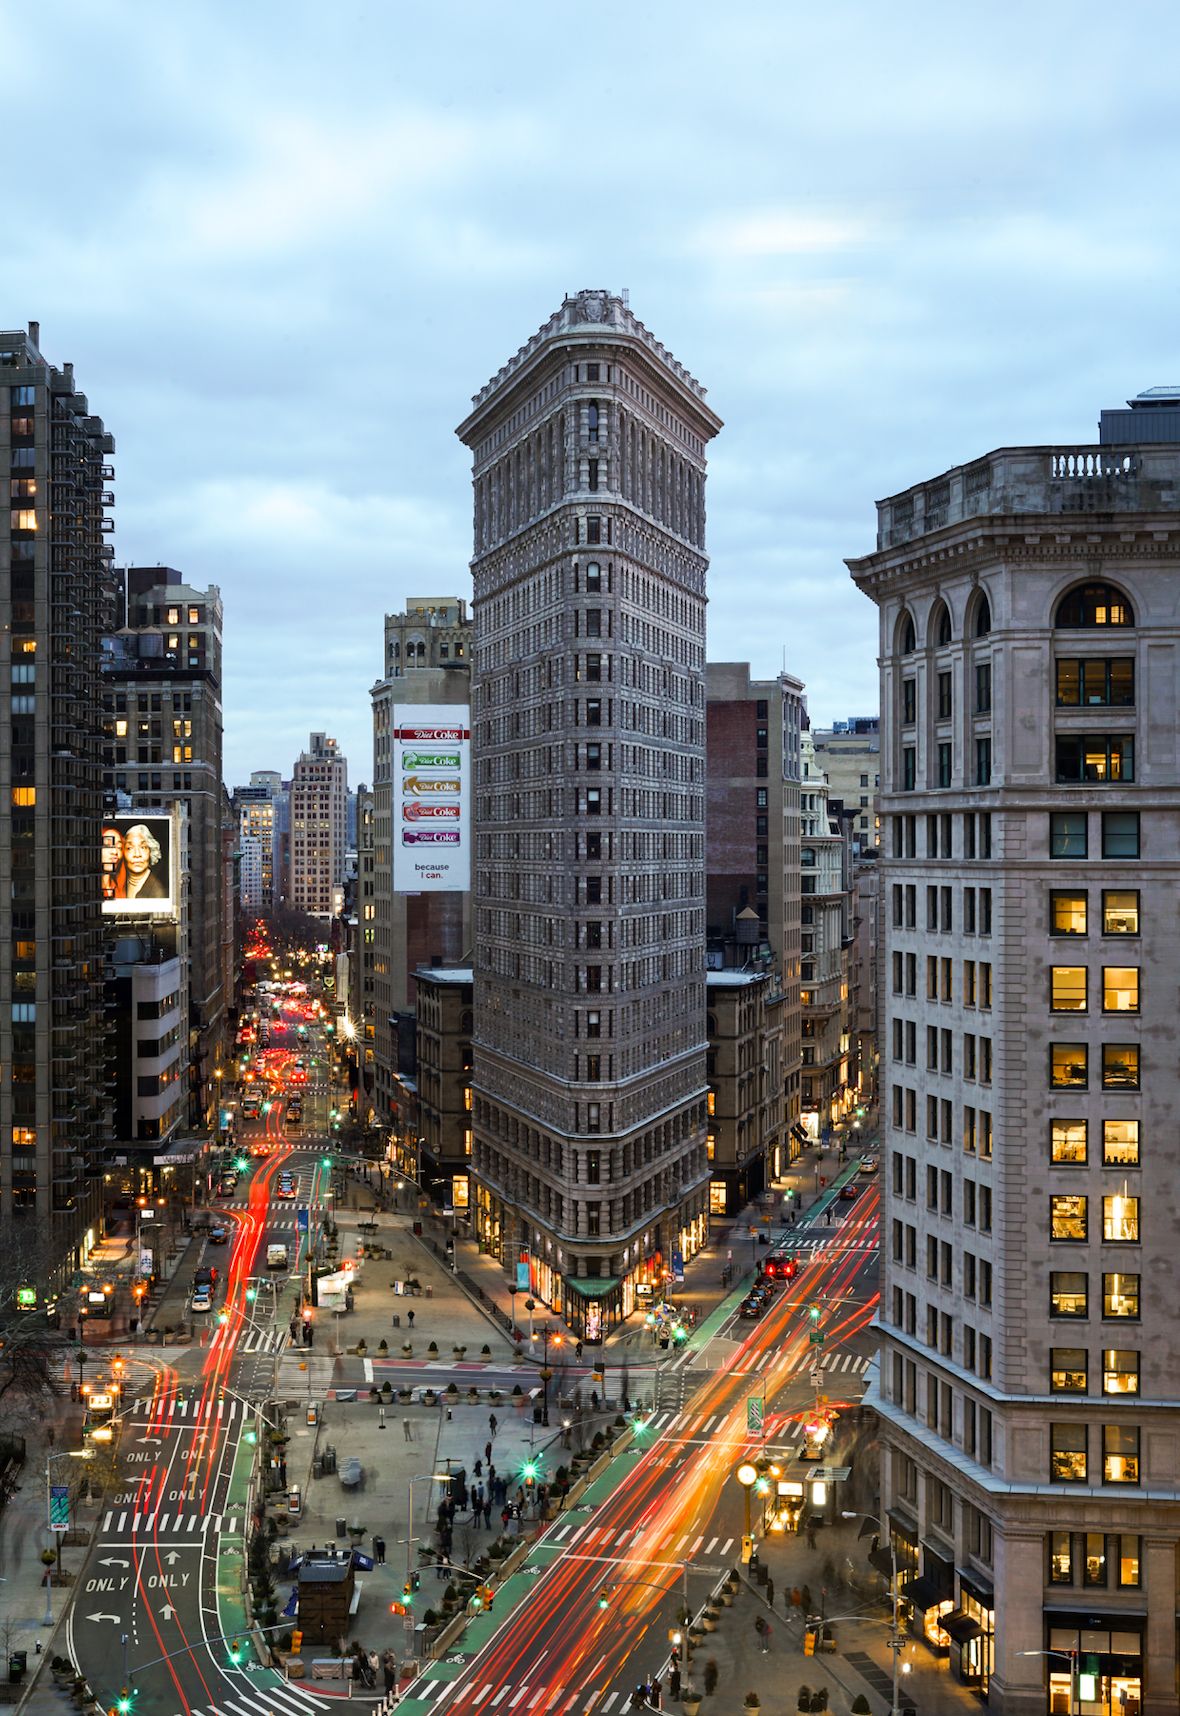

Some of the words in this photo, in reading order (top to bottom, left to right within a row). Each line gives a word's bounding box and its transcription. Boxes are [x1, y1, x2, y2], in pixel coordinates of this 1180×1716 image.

[414, 730, 433, 739] Diet
[434, 730, 458, 739] Coke
[419, 757, 433, 765] Diet
[434, 757, 456, 765] Coke
[419, 782, 433, 790] Diet
[434, 782, 456, 791] Coke
[434, 807, 456, 816] Coke
[434, 833, 456, 842] Coke
[127, 1451, 162, 1462] ONLY
[181, 1449, 216, 1460] ONLY
[647, 1457, 686, 1469] ONLY
[113, 1491, 152, 1504] ONLY
[169, 1489, 206, 1501] ONLY
[86, 1577, 129, 1592] ONLY
[148, 1573, 190, 1588] ONLY
